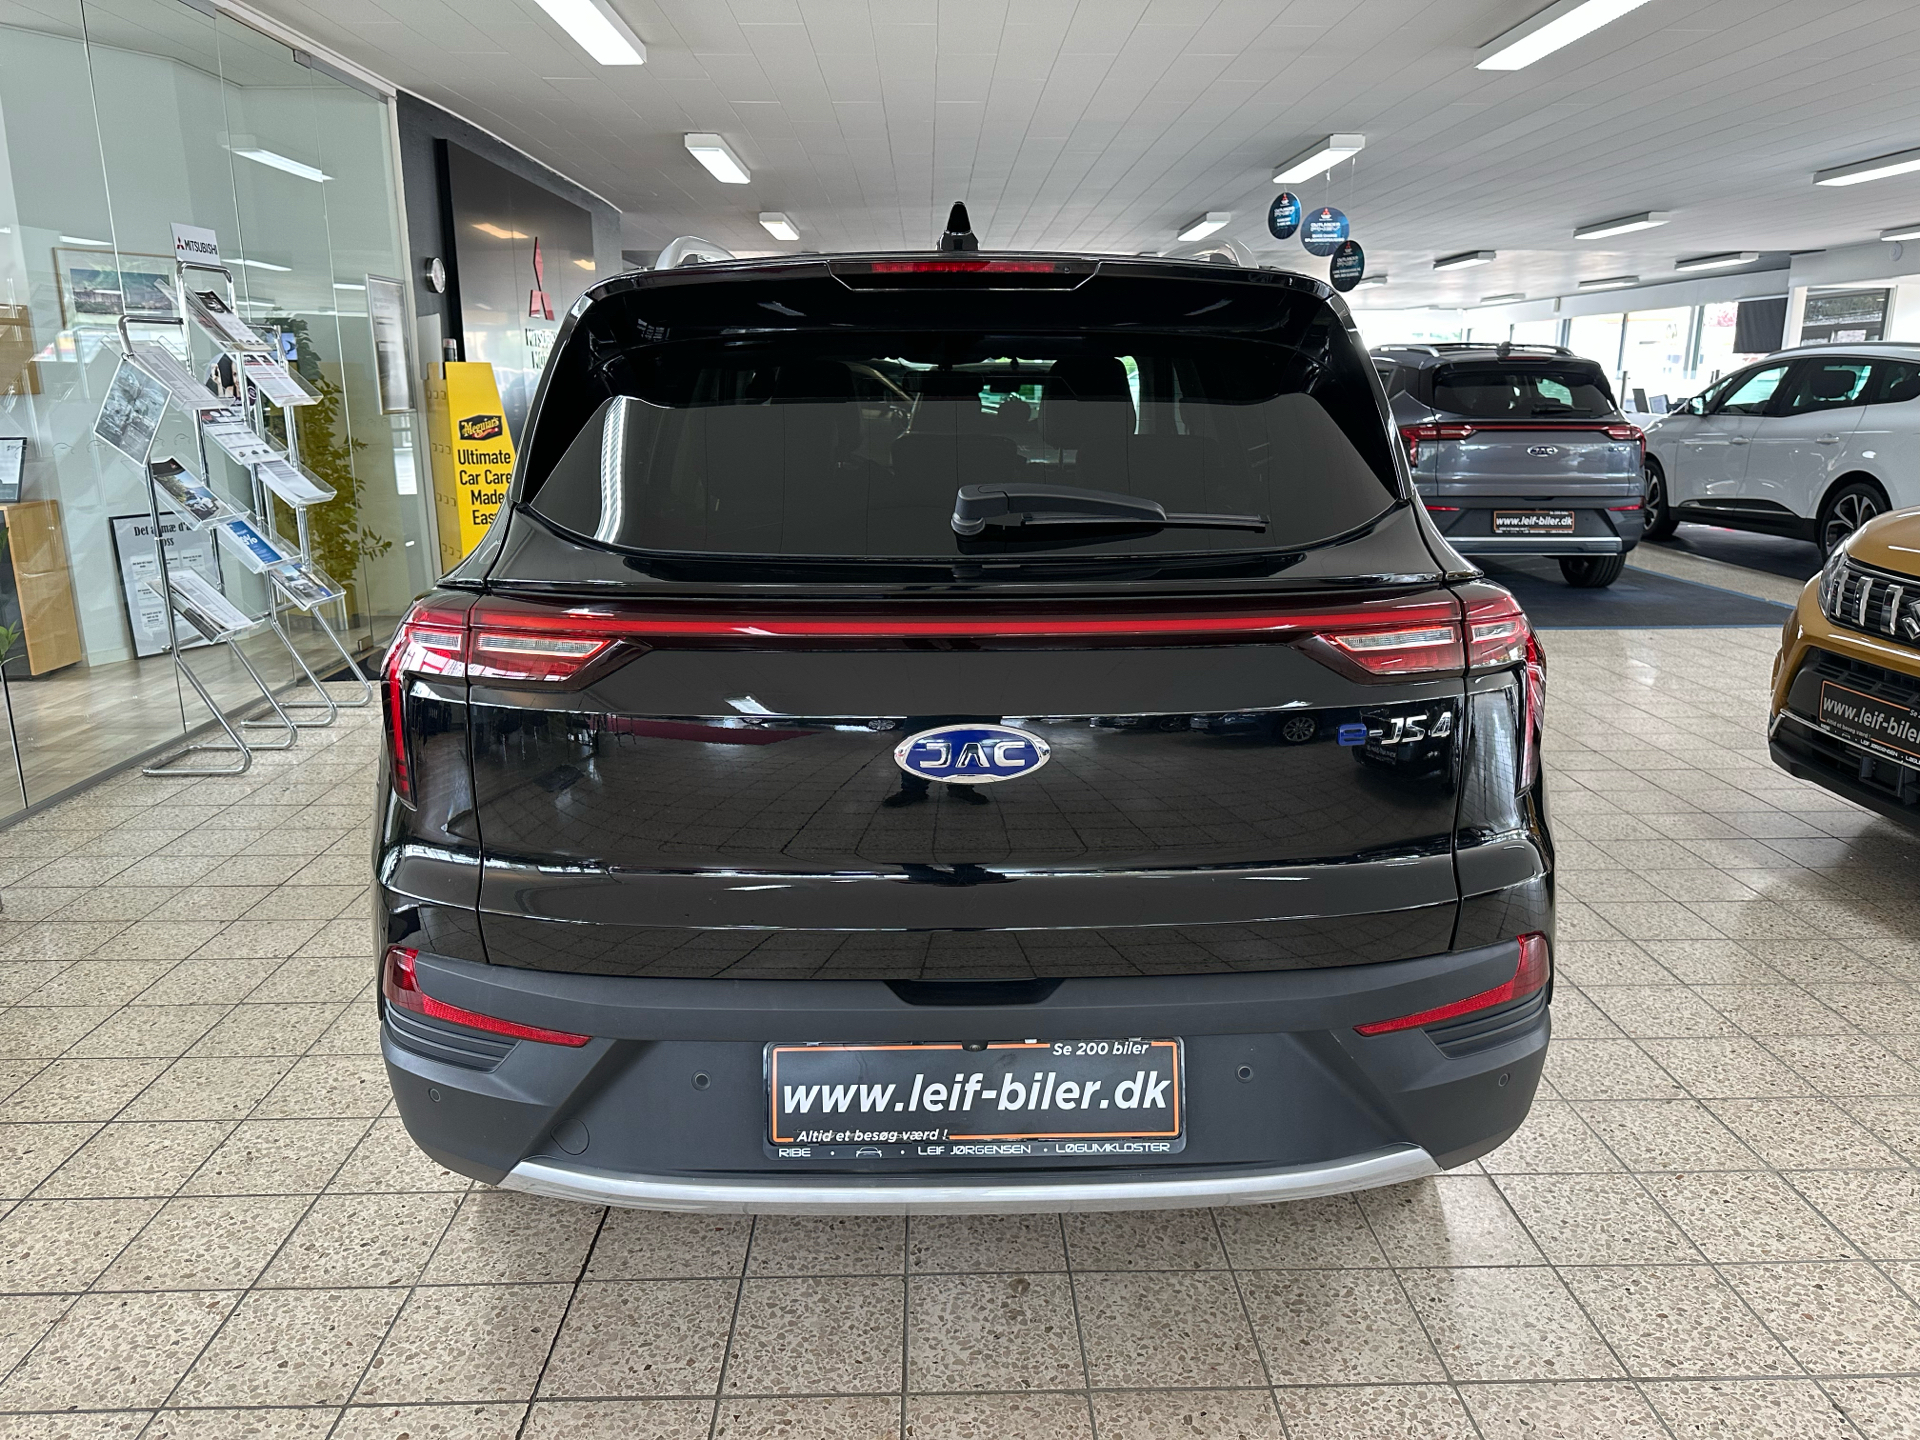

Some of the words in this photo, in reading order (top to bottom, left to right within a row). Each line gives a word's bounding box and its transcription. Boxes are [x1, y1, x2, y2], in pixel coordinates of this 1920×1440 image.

[184, 239, 218, 255] MITSUBISHI
[457, 449, 511, 465] Ultimate
[459, 469, 481, 485] Car
[484, 469, 512, 485] Care
[470, 489, 505, 505] Made
[1496, 516, 1573, 526] www.leif-biler.dk
[133, 525, 149, 536] Det
[919, 741, 1026, 768] JAC
[1052, 1043, 1071, 1056] Se
[1075, 1042, 1109, 1056] 200
[1112, 1041, 1151, 1055] biler
[783, 1070, 1172, 1114] www.leif-biler.dk
[796, 1129, 832, 1142] Altid
[836, 1131, 850, 1142] et
[853, 1129, 898, 1145] besøg
[903, 1129, 939, 1141] værd
[778, 1148, 812, 1158] RIBE
[917, 1145, 945, 1156] LEIF
[950, 1145, 1032, 1155] JØRGENSEN
[1055, 1142, 1171, 1153] LØGUMKLOSTER
